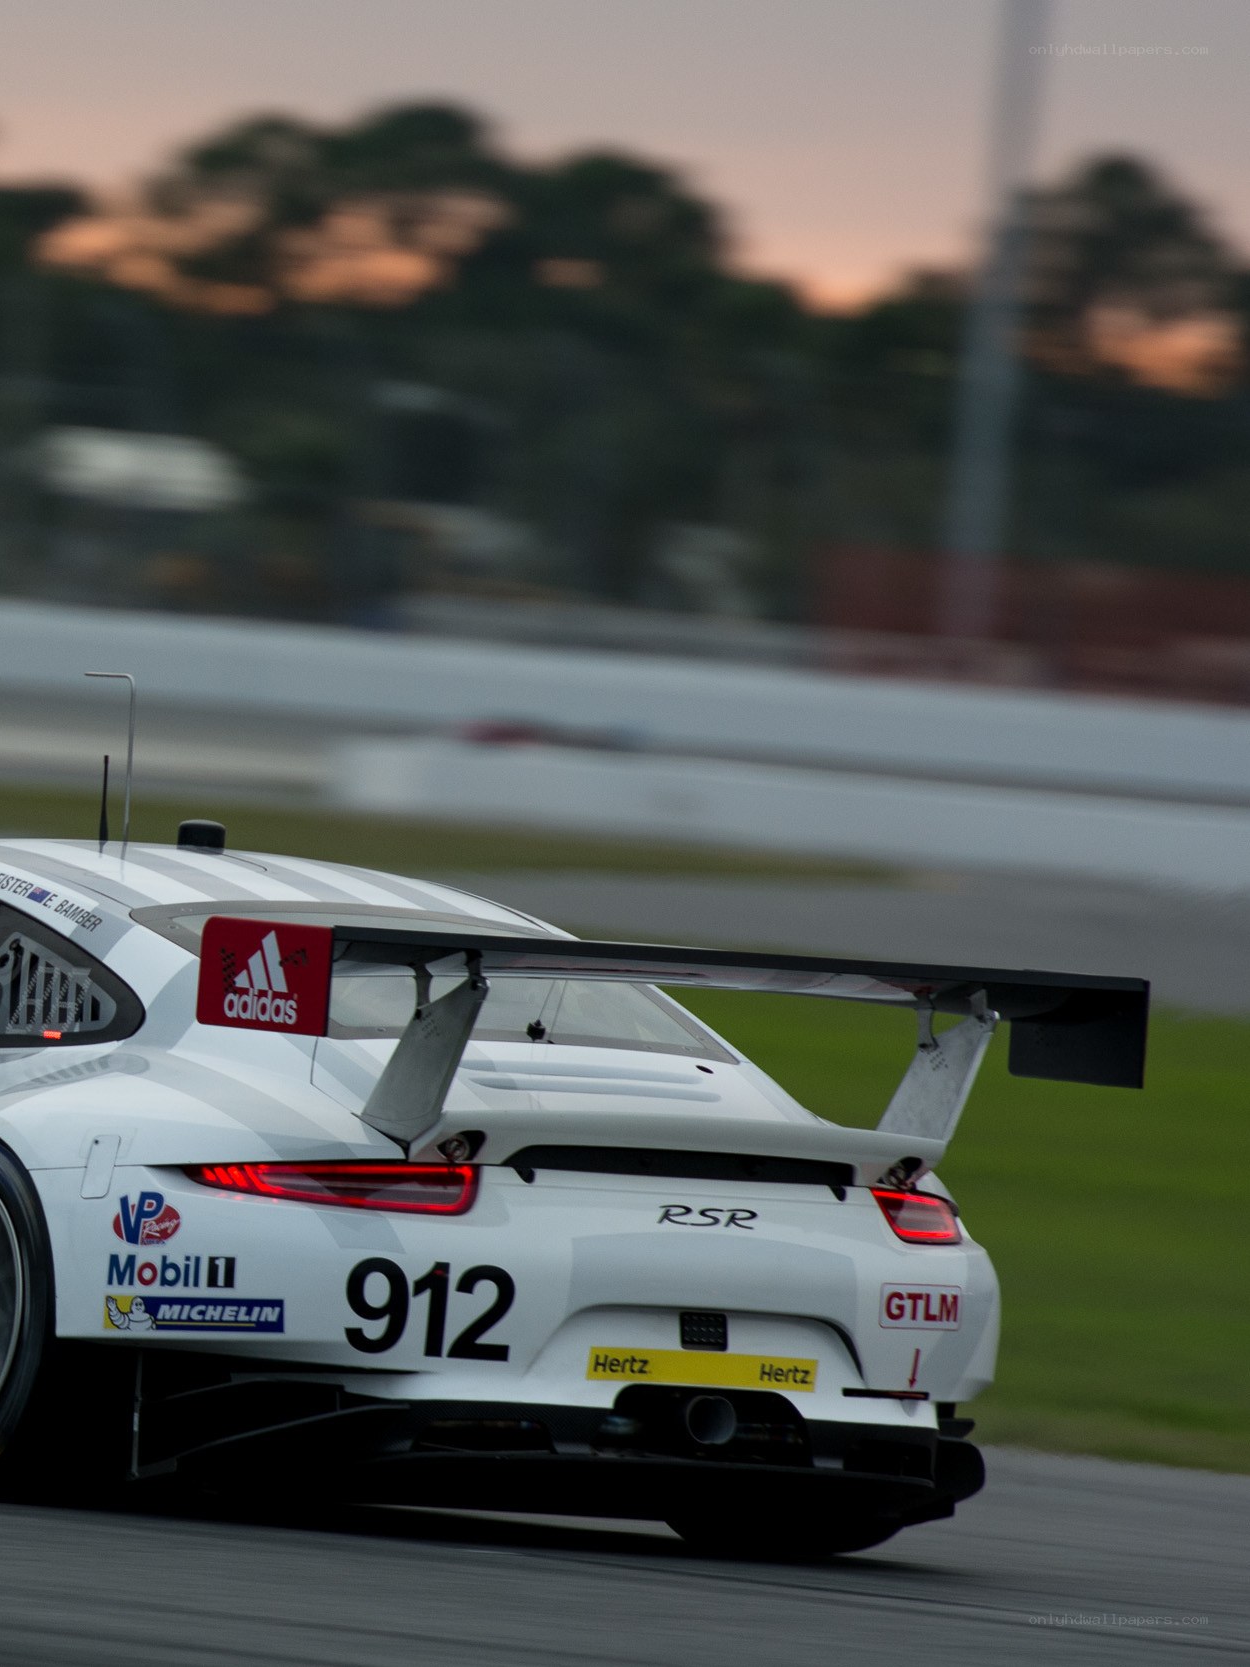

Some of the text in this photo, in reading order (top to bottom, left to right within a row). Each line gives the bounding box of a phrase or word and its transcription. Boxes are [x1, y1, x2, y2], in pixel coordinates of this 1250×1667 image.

[42, 894, 103, 932] E. BAMBER
[223, 988, 298, 1025] adidas
[120, 1191, 165, 1246] VP
[657, 1204, 758, 1230] RSR
[107, 1254, 200, 1288] Mobil
[156, 1303, 281, 1323] MICHELIN
[343, 1256, 516, 1362] 912
[885, 1290, 960, 1323] GTLM
[593, 1354, 649, 1375] Hertz
[759, 1363, 810, 1386] Hertz
